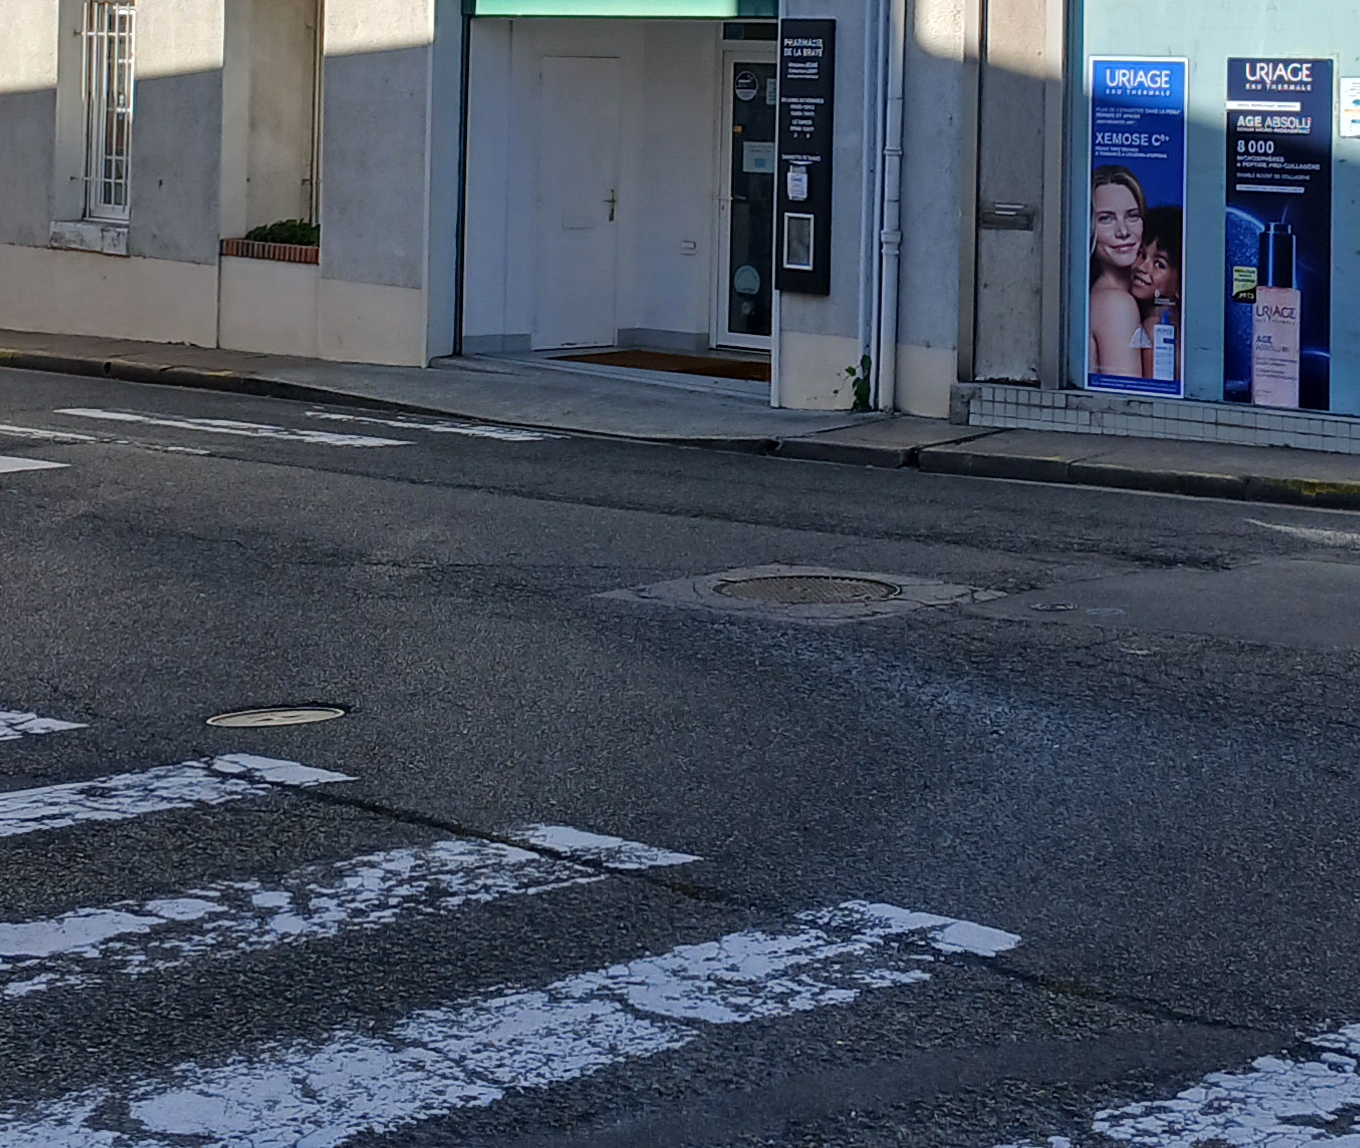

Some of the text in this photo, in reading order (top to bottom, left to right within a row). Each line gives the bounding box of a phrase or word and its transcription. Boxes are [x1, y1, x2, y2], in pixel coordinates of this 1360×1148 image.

[1106, 69, 1171, 89] URIAGE
[1245, 63, 1313, 83] URIAGE
[1237, 115, 1311, 128] AGE ABSOLU
[1095, 132, 1149, 146] XEMOSE
